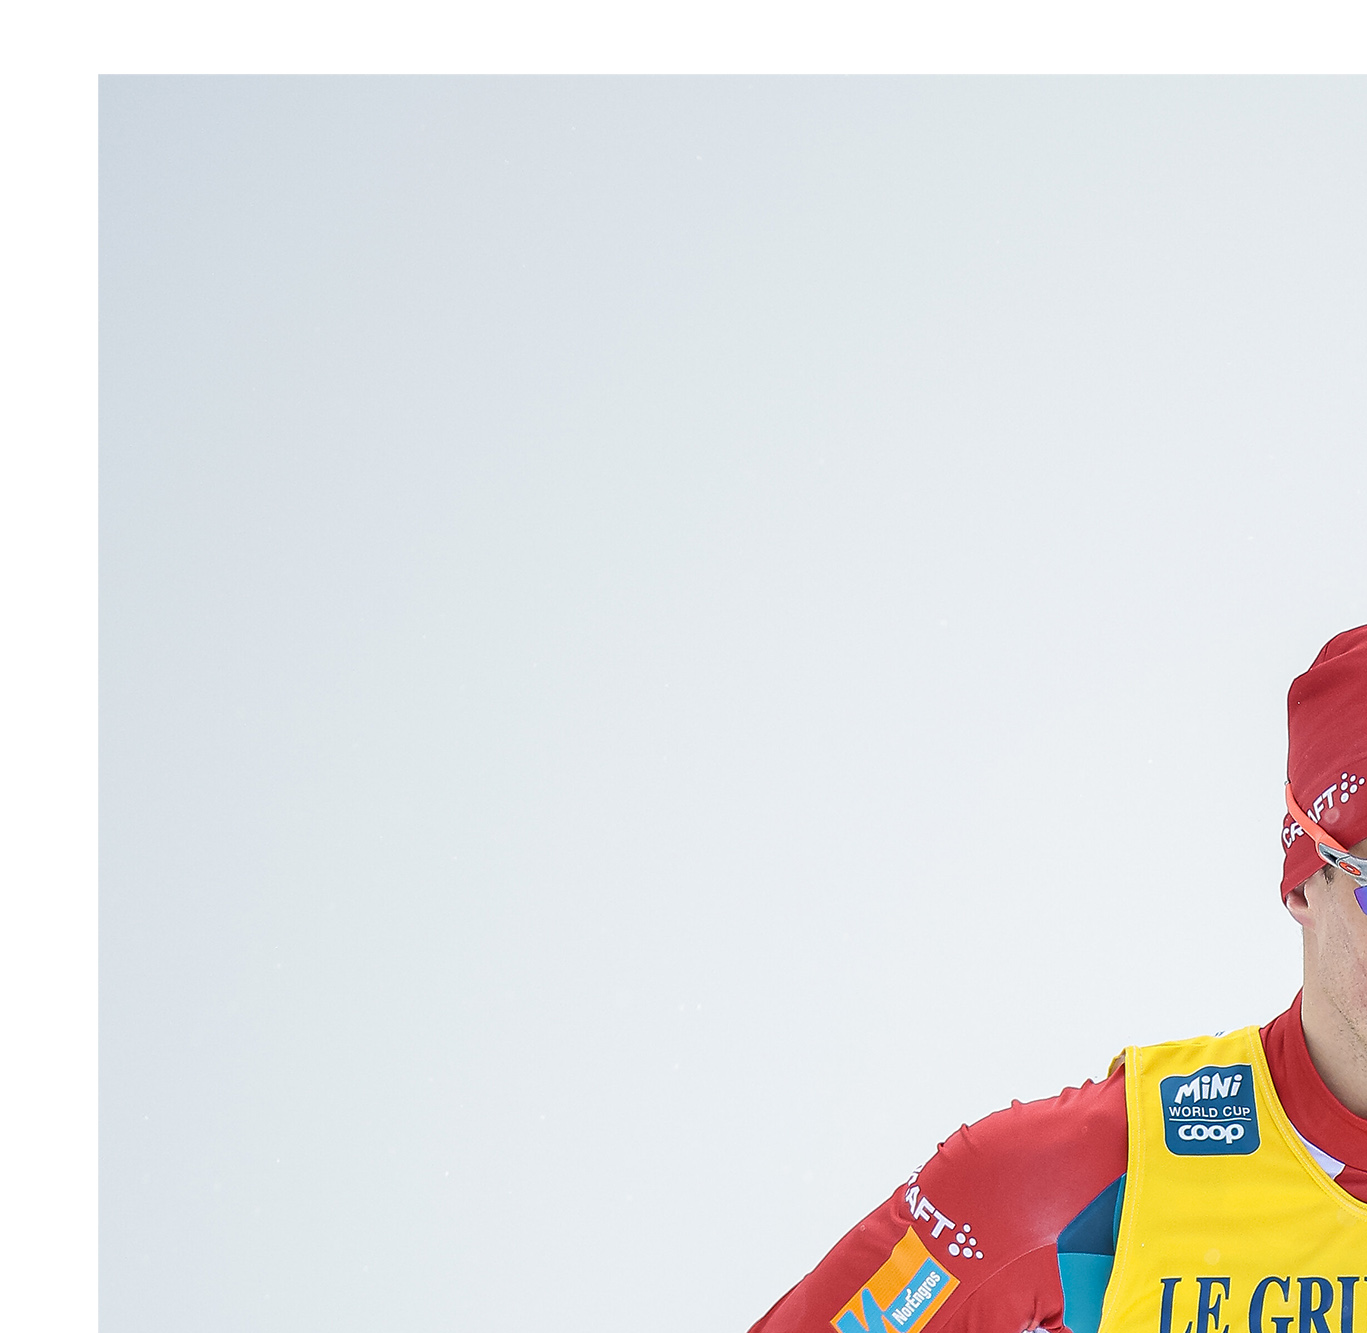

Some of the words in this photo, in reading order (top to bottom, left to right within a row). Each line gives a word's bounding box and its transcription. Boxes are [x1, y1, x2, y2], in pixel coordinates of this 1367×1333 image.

[1168, 1105, 1218, 1118] WORLD
[1221, 1105, 1251, 1118] CUP
[1178, 1122, 1245, 1144] coop
[891, 1270, 941, 1327] NorEngros
